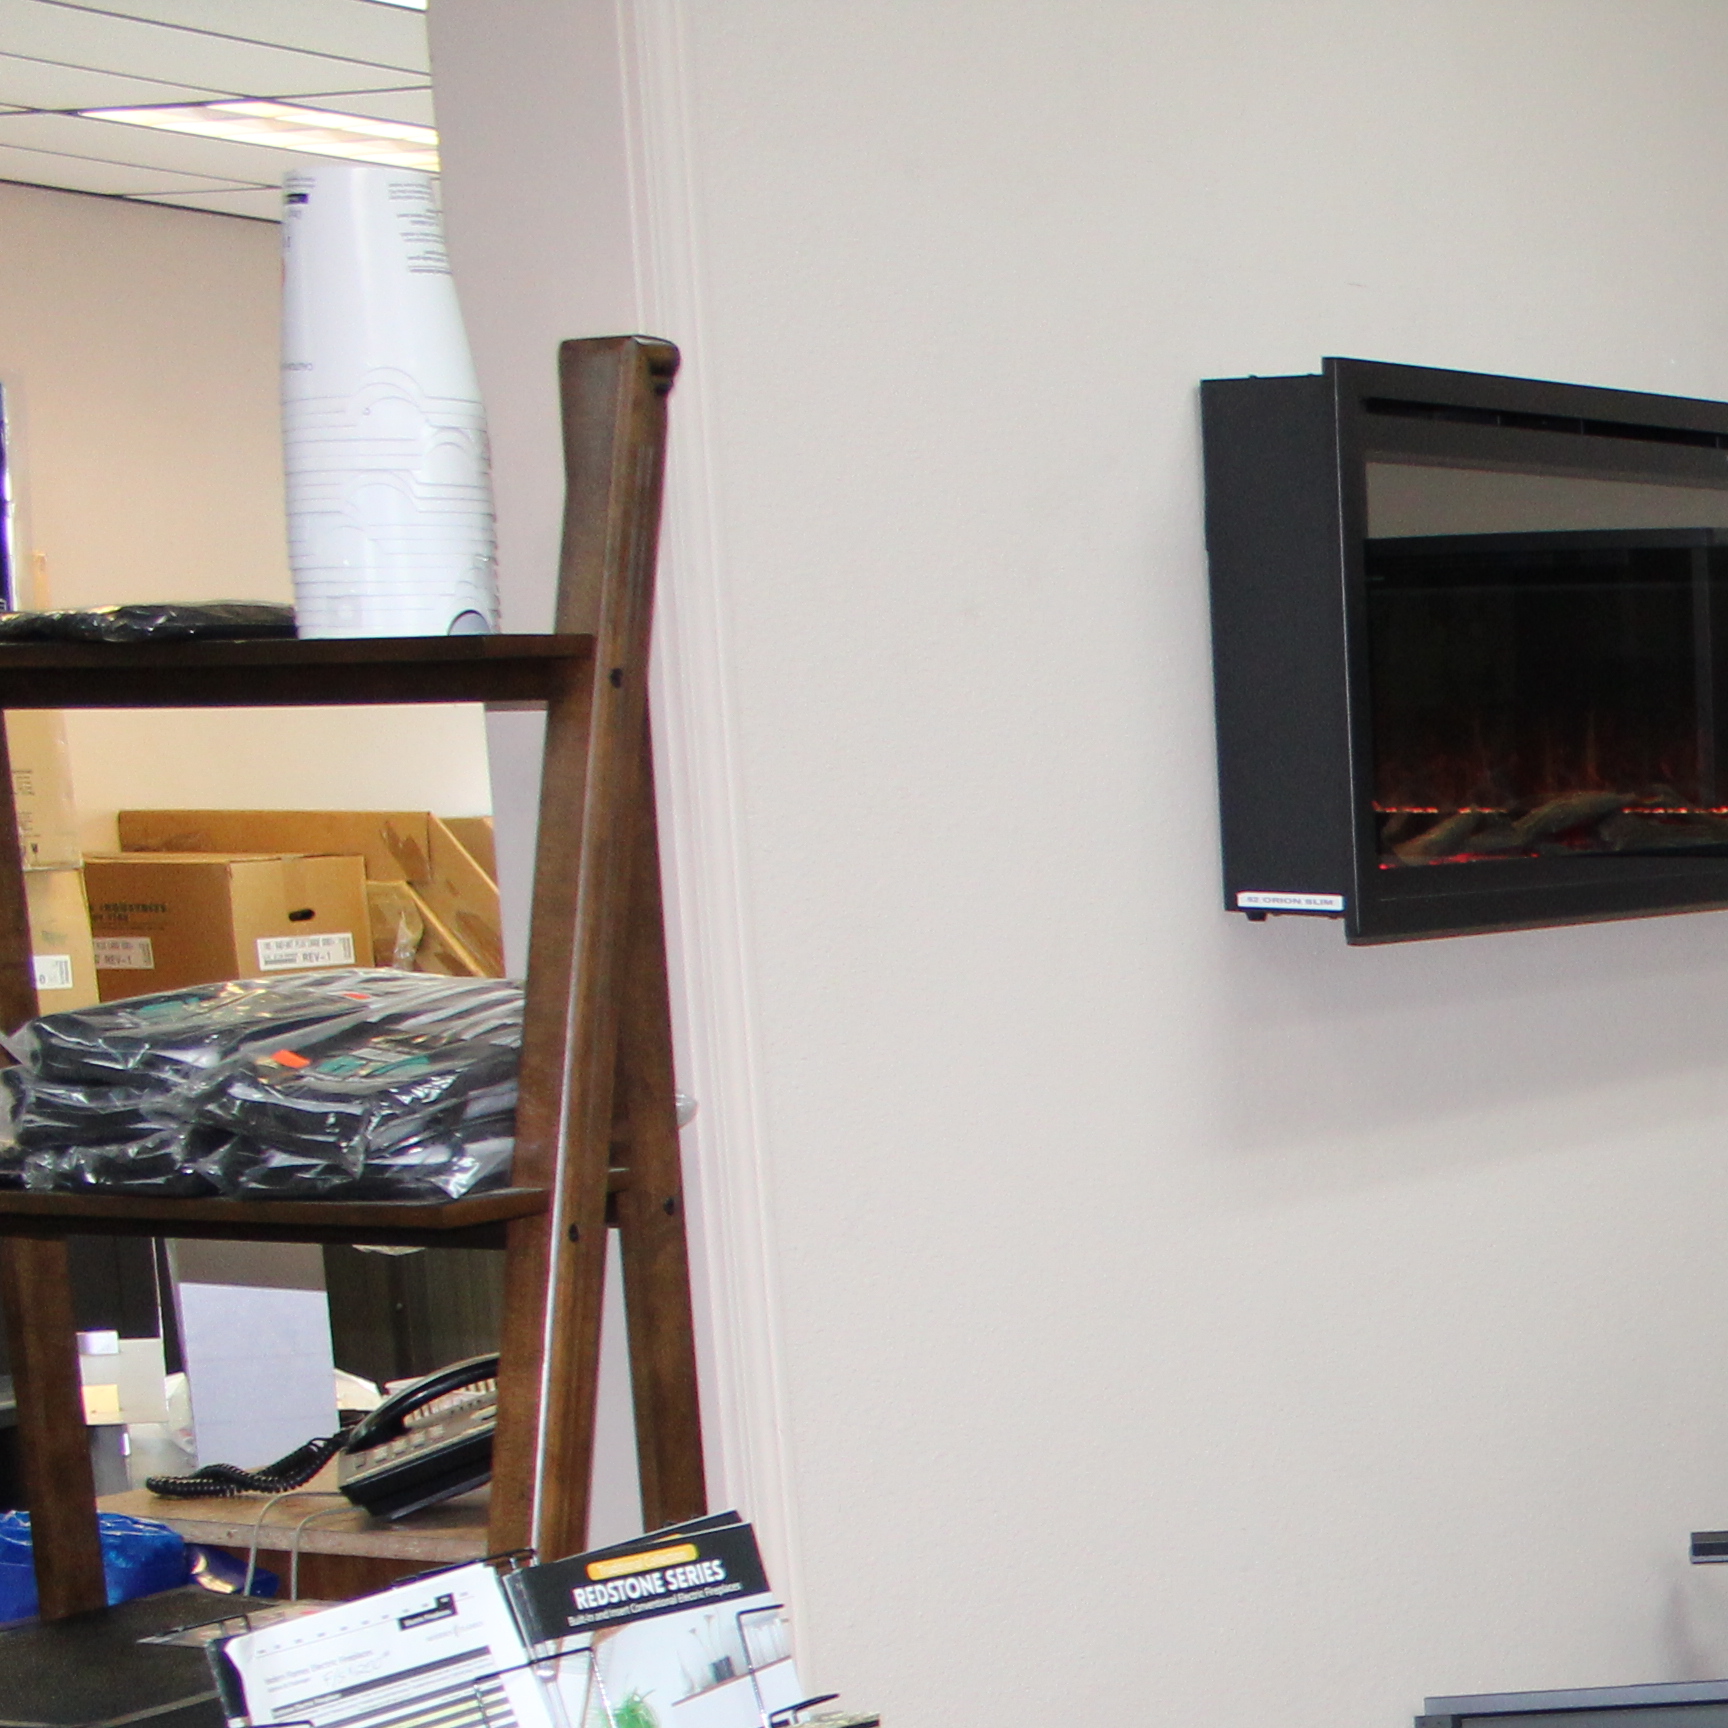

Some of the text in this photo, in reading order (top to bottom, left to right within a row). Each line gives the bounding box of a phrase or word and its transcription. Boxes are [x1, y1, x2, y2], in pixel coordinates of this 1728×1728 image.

[1262, 896, 1301, 905] ORION
[1305, 898, 1334, 906] SLIM
[572, 1558, 727, 1610] REDSTONE SERIES
